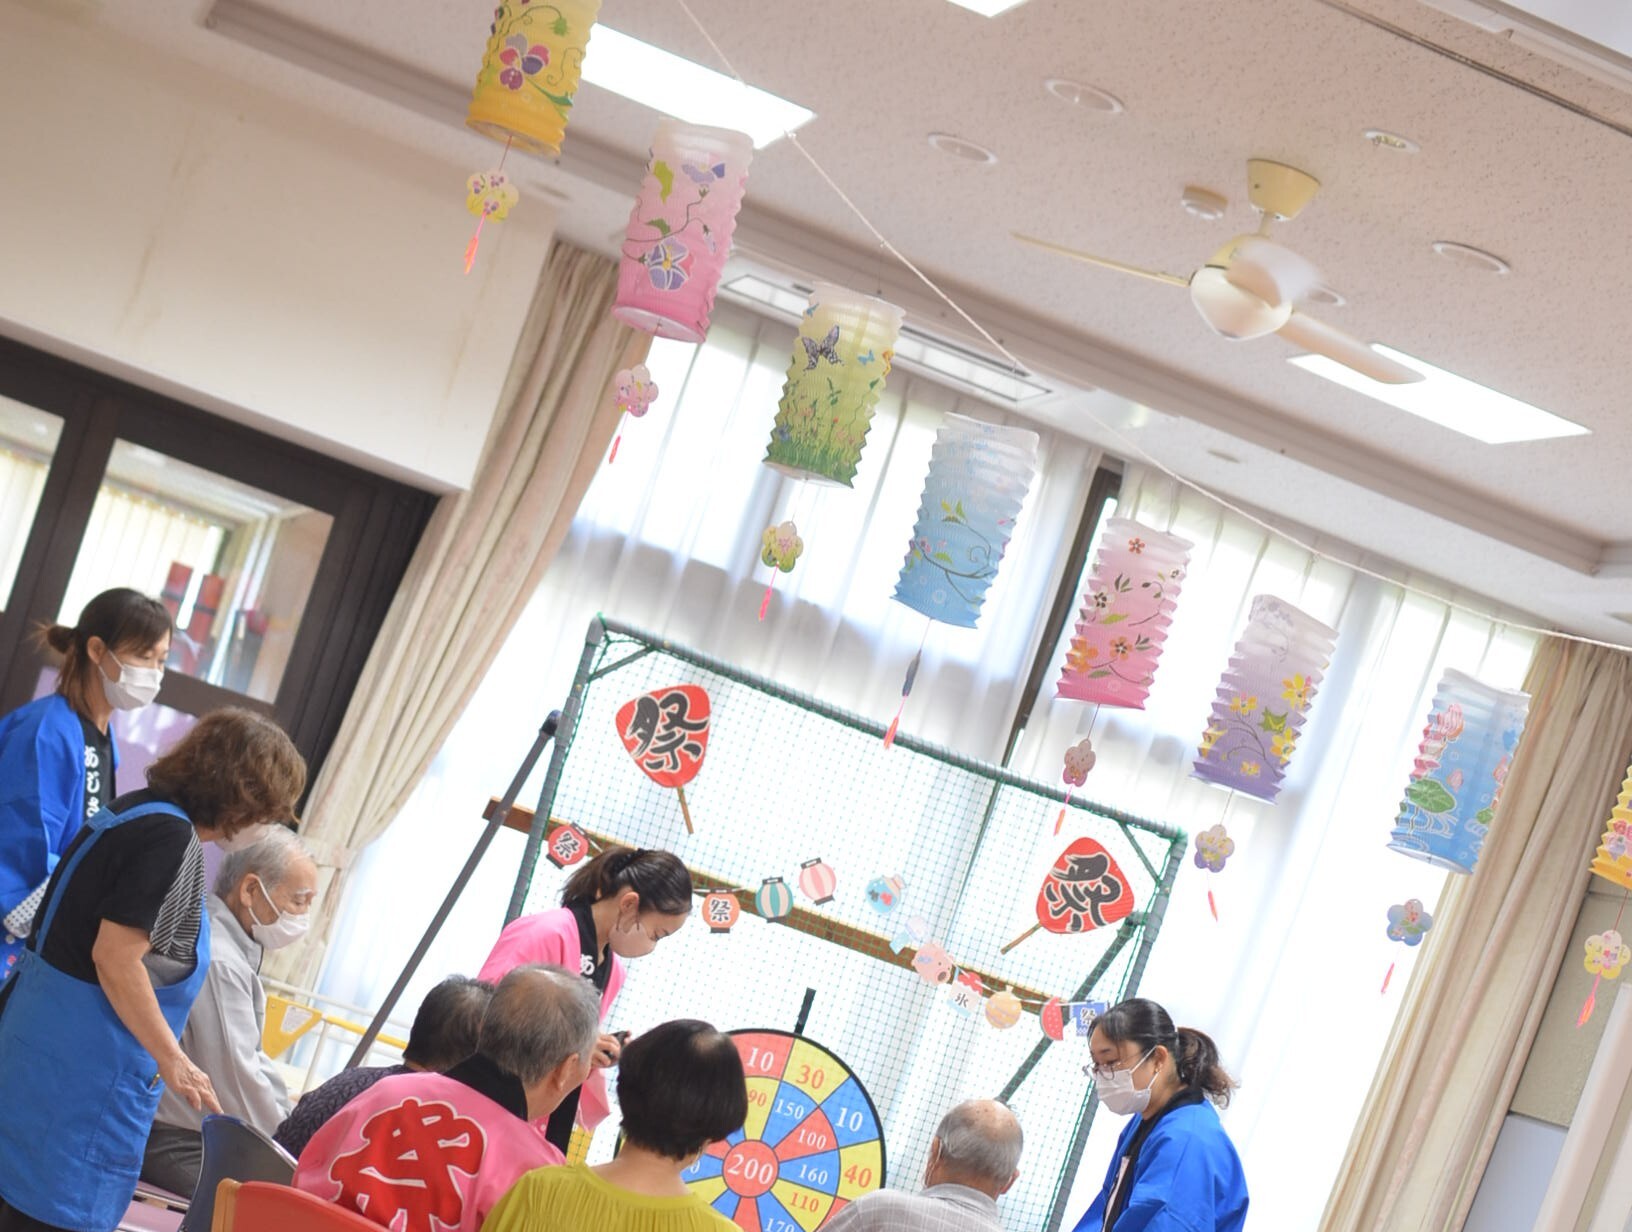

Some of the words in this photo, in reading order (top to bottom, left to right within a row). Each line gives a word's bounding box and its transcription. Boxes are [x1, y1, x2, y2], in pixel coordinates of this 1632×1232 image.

[625, 691, 711, 771] 祭
[554, 830, 582, 859] 祭
[1044, 852, 1123, 934] 祭
[708, 898, 732, 922] 祭
[954, 992, 969, 1009] 氷
[746, 1047, 774, 1072] 10
[795, 1064, 825, 1089] 30
[774, 1099, 805, 1121] 150
[835, 1106, 864, 1132] 10
[798, 1128, 827, 1150] 100
[727, 1153, 774, 1185] 200
[798, 1164, 829, 1186] 160
[843, 1163, 872, 1189] 40
[789, 1192, 820, 1213] 110
